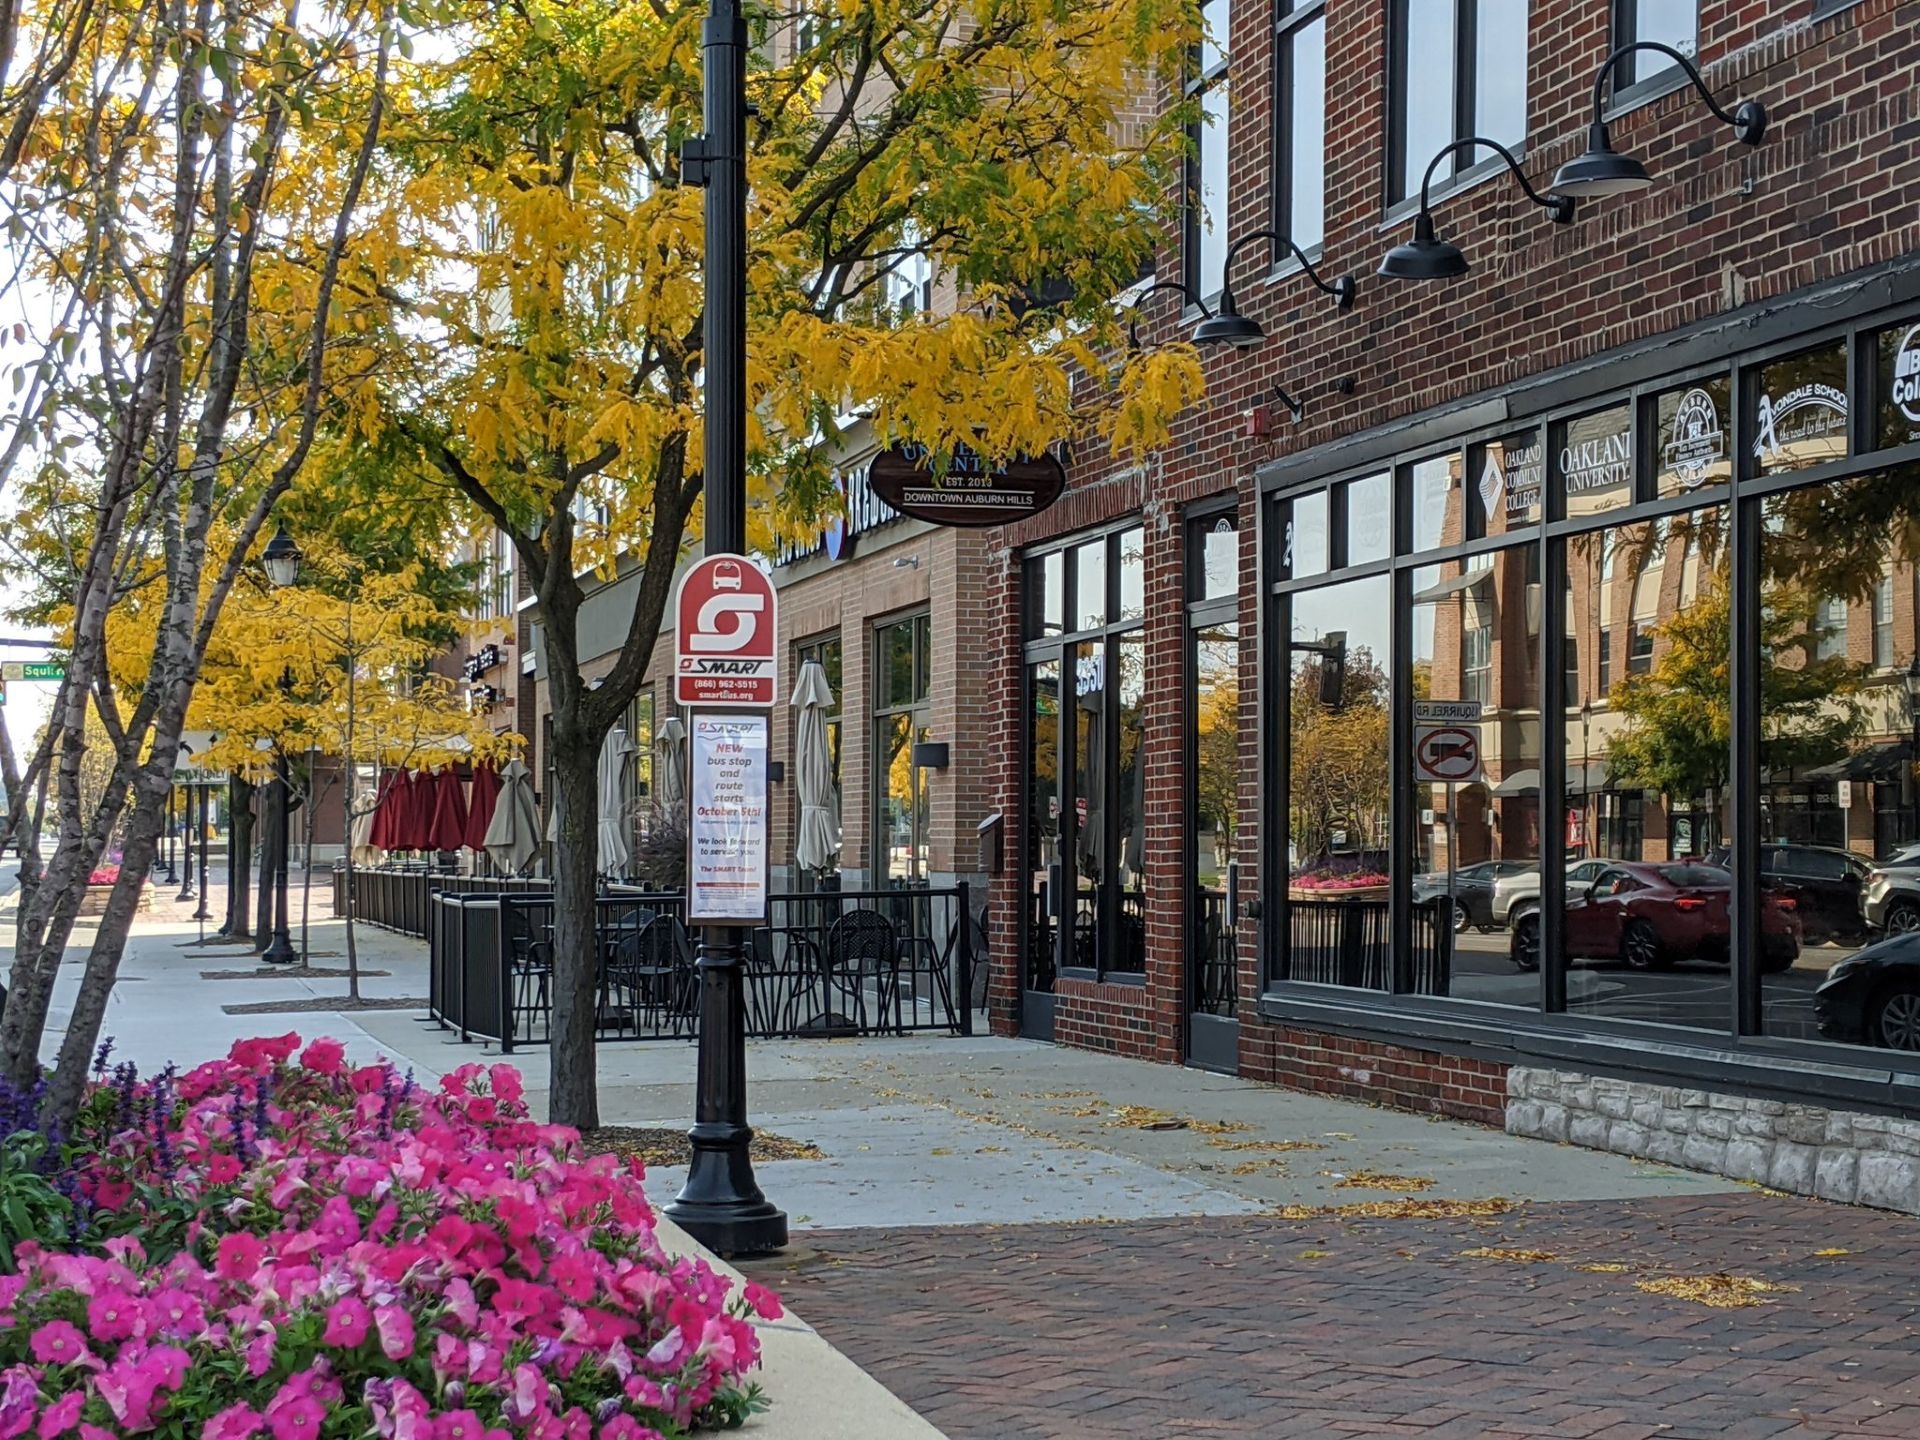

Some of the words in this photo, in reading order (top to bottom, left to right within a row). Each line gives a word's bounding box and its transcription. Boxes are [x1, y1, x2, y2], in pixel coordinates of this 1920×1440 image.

[1893, 375, 1920, 405] Col
[1780, 422, 1790, 442] the
[1505, 444, 1542, 468] OAKLAND
[928, 456, 1008, 475] CNTR
[946, 478, 965, 486] EST.
[904, 492, 963, 503] DOWNTOWN
[965, 494, 1005, 504] AUBURN
[1006, 495, 1033, 504] HILLS
[691, 658, 773, 674] SMART
[716, 743, 744, 753] NEW
[707, 756, 726, 765] bus
[729, 757, 752, 768] stop
[720, 769, 740, 778] and
[715, 781, 744, 790] route
[714, 794, 744, 803] starts
[697, 806, 738, 816] October
[697, 837, 710, 846] We
[711, 836, 728, 846] look
[700, 847, 709, 856] to
